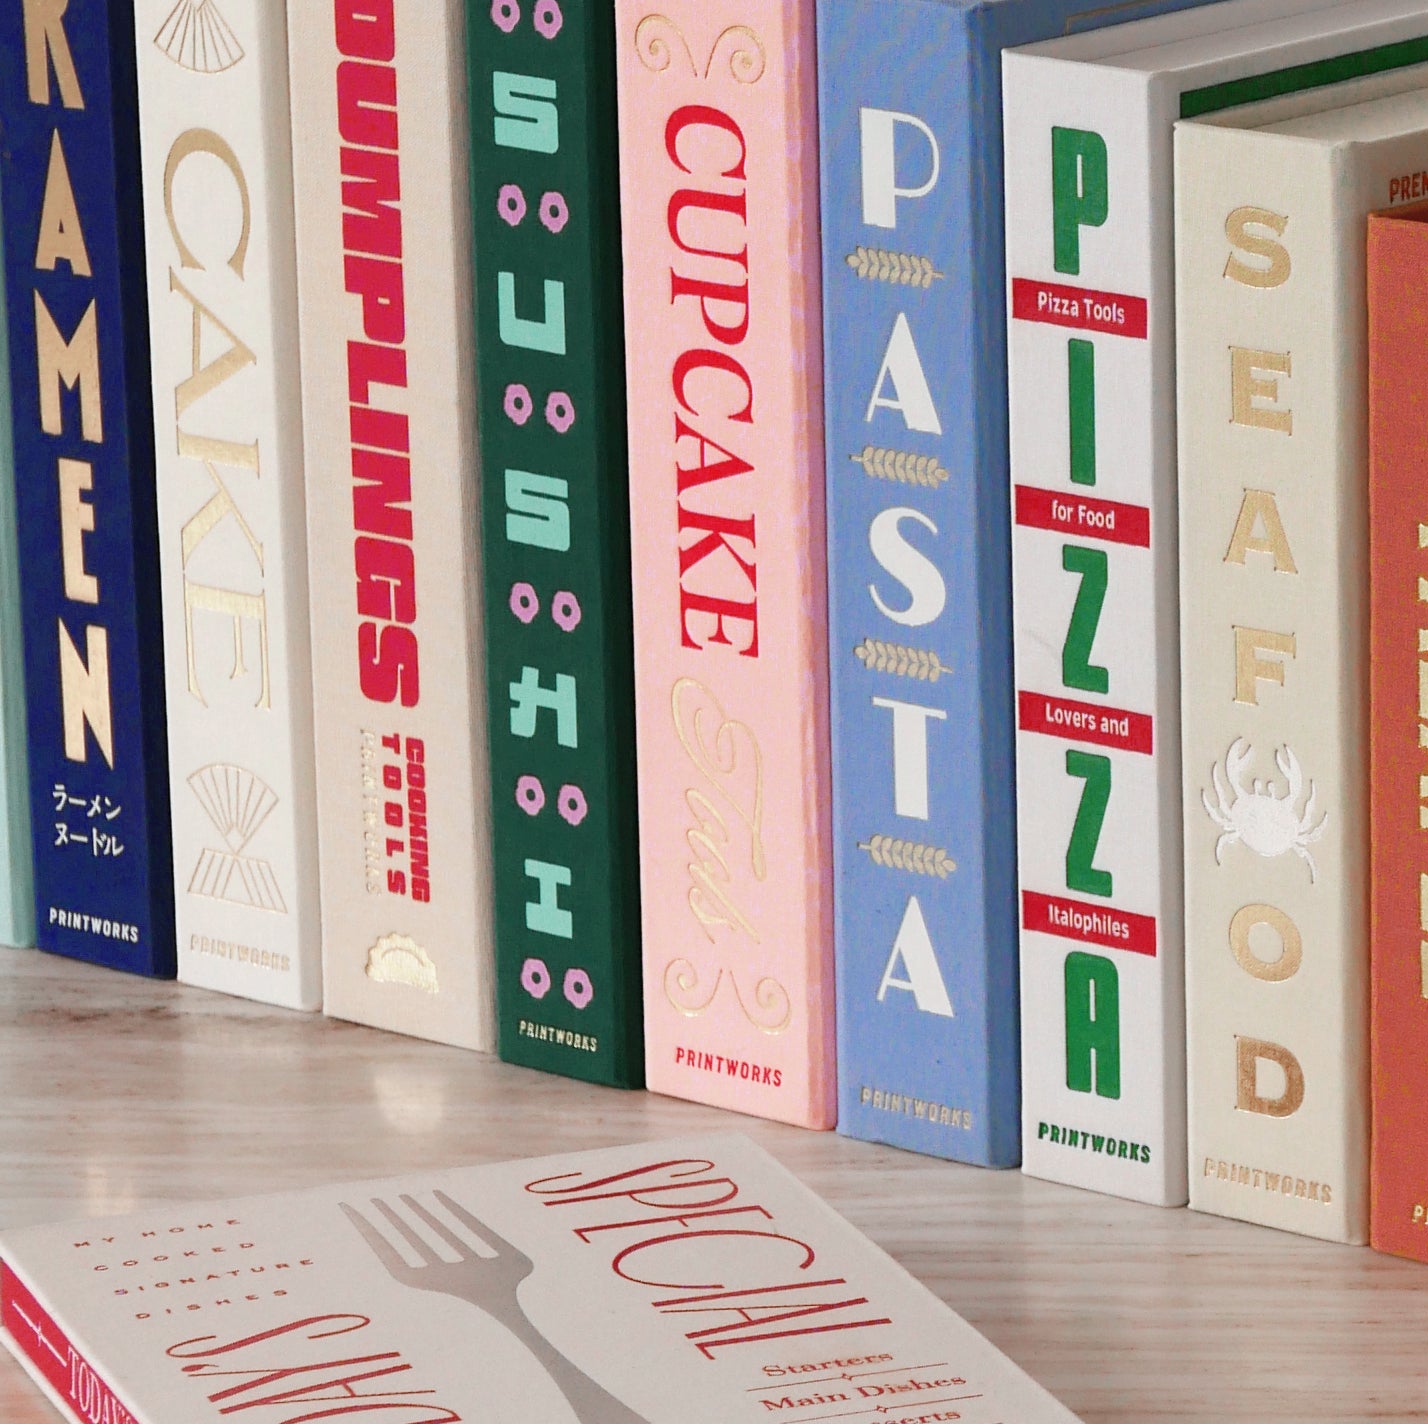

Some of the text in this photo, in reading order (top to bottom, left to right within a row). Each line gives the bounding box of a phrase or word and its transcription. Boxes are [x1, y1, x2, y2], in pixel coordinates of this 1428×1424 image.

[1036, 290, 1126, 325] Pizza Tools
[663, 103, 760, 660] CUPCAKE
[163, 126, 272, 711] CAKE
[1051, 500, 1116, 530] for Food
[858, 106, 955, 1018] PASTA
[1050, 125, 1121, 1101] PIZZA
[1044, 701, 1130, 737] Lovers and
[51, 783, 122, 822] ラーメン
[381, 732, 407, 896] TOOLS
[405, 736, 431, 904] COOKING
[54, 822, 125, 857] ヌードル
[48, 906, 140, 945] PRINTWORKS
[1048, 903, 1131, 941] Italophiles
[189, 933, 291, 972] PRINTWORKS
[518, 1018, 598, 1054] PRINTWORKS
[674, 1046, 783, 1088] PRINTWORKS
[859, 1084, 974, 1131] PRINTWORKS
[1038, 1120, 1152, 1165] PRINTWORKS
[1203, 1157, 1334, 1206] PRINTWORKS
[73, 1218, 241, 1248] MY HOME
[93, 1241, 255, 1272] COOKED
[524, 1158, 893, 1361] SPECIAL
[113, 1258, 314, 1296] SIGNATURE
[134, 1289, 288, 1320] DISHES
[762, 1351, 894, 1378] Starters
[758, 1374, 967, 1413] Main Dishes
